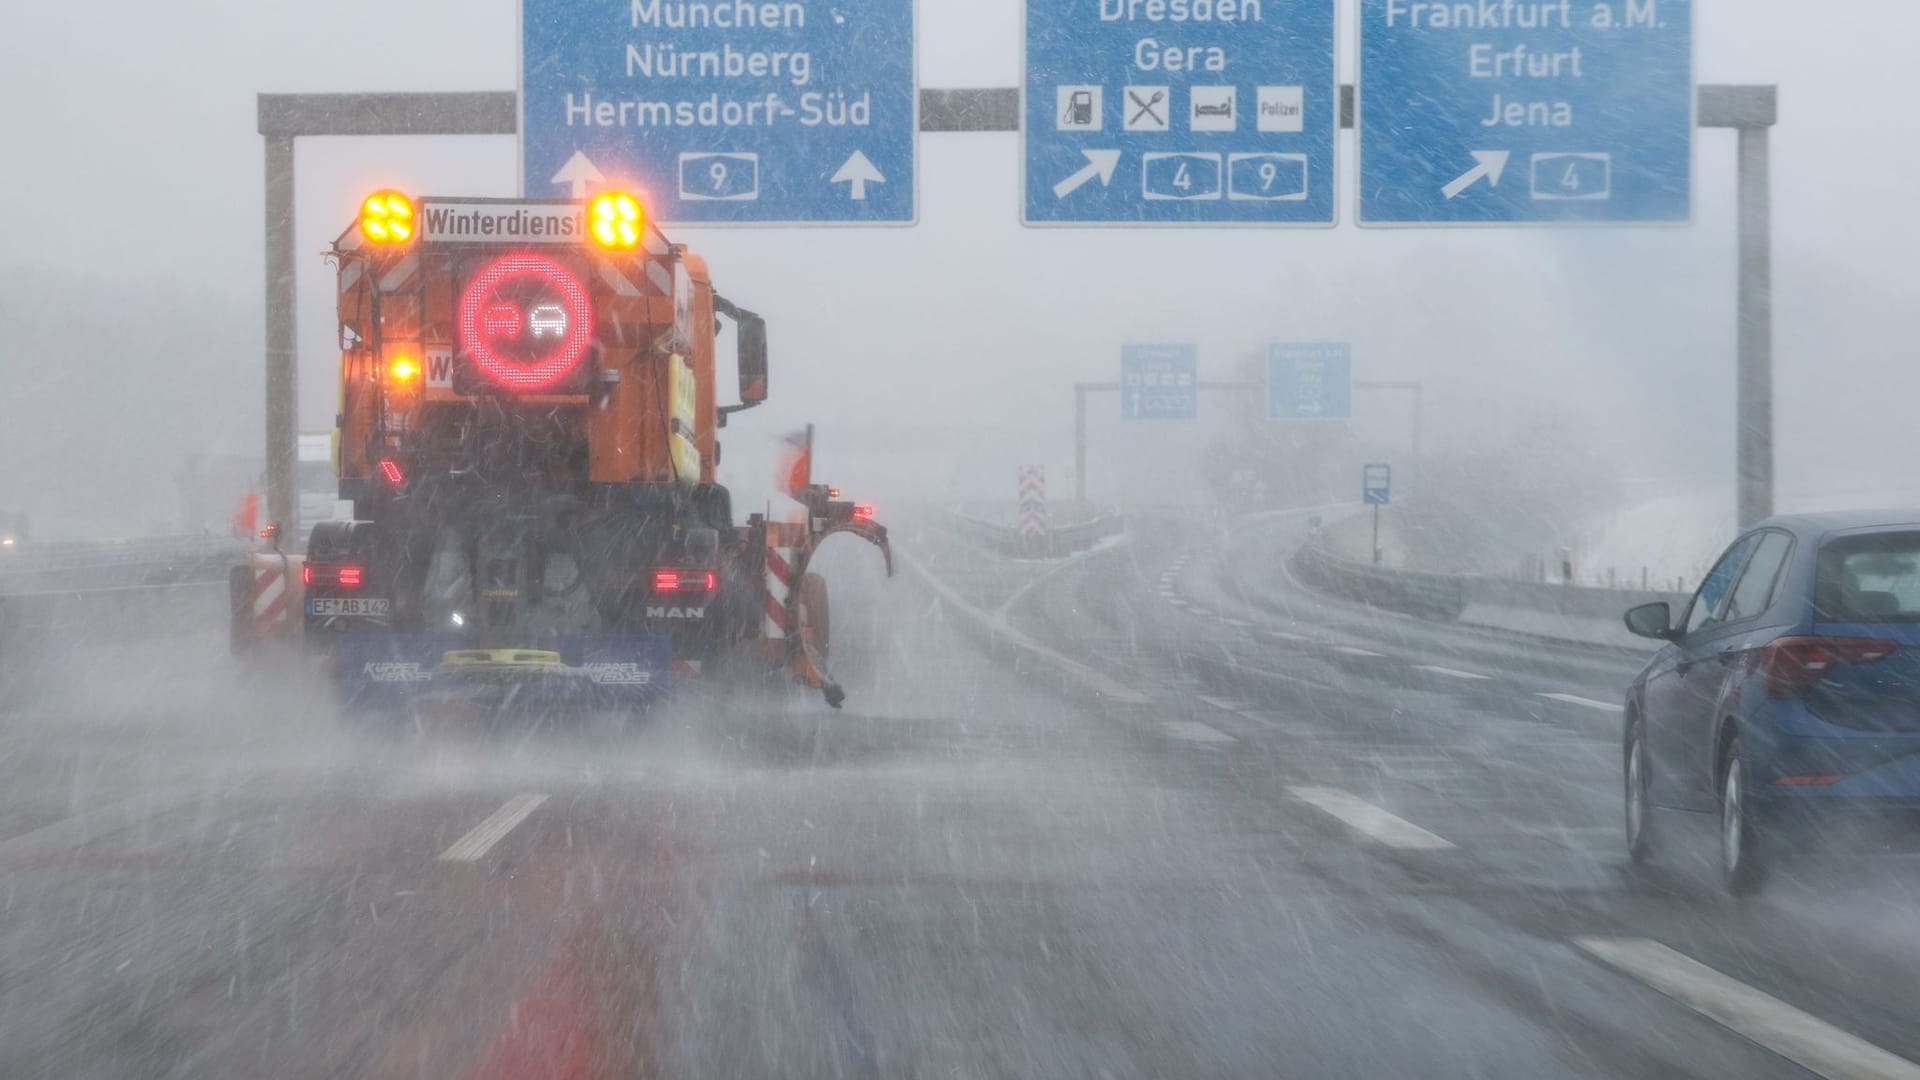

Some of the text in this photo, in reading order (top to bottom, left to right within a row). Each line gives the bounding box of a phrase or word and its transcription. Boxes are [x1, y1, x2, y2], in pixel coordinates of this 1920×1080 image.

[1099, 0, 1262, 21] Dresden
[1386, 0, 1571, 29] Frankfurt
[626, 44, 811, 85] Nürnberg
[1134, 38, 1226, 71] Gera
[1469, 43, 1583, 78] Erfurt
[565, 92, 871, 127] Hermsdorf-Süd
[1260, 101, 1300, 117] Polizei
[1480, 94, 1572, 127] Jena
[709, 162, 727, 191] 9
[1172, 162, 1192, 190] 4
[1259, 162, 1276, 191] 9
[1561, 162, 1580, 190] 4
[425, 208, 584, 236] Winterdienst
[646, 606, 705, 618] MAN
